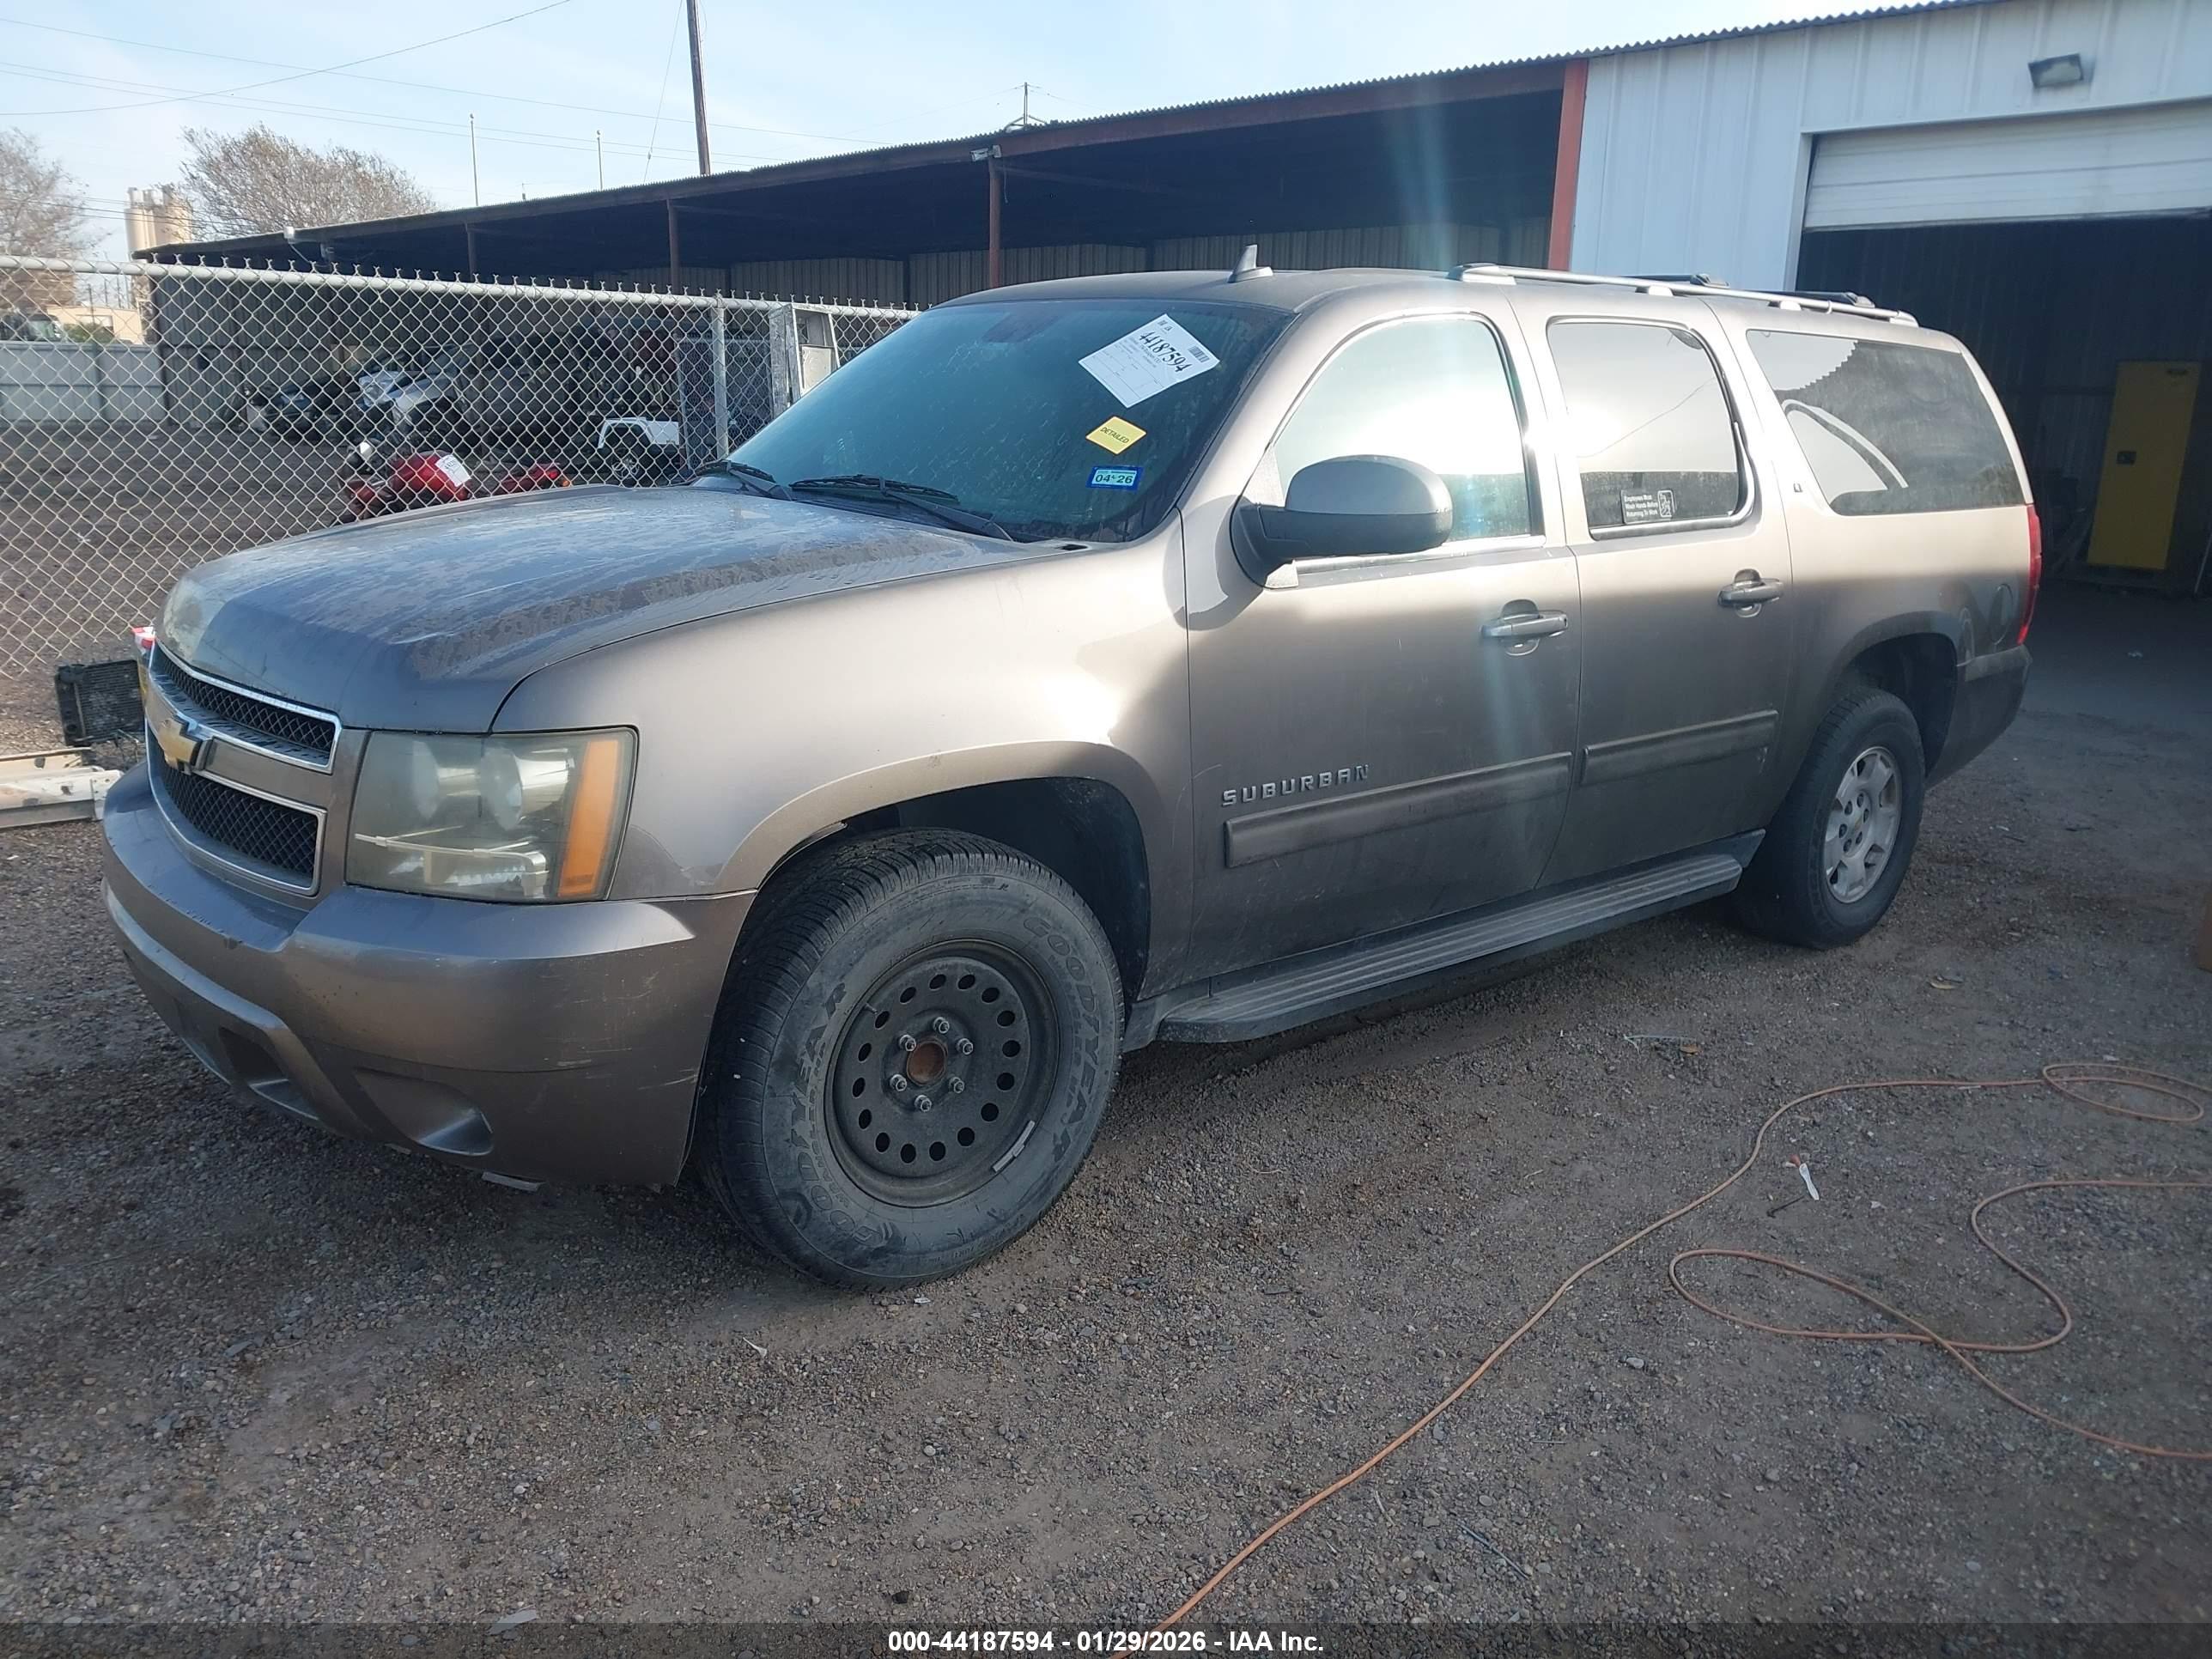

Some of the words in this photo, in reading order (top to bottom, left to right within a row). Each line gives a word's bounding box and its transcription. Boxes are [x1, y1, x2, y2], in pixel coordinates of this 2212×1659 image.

[1139, 331, 1193, 372] 44187594
[1100, 426, 1130, 444] DETAILED
[1095, 473, 1110, 483] 04
[1117, 474, 1133, 483] 26
[1221, 764, 1369, 807] SUBURBAN
[1023, 916, 1100, 1164] GOODYEAR
[790, 982, 884, 1245] GOODYEAR
